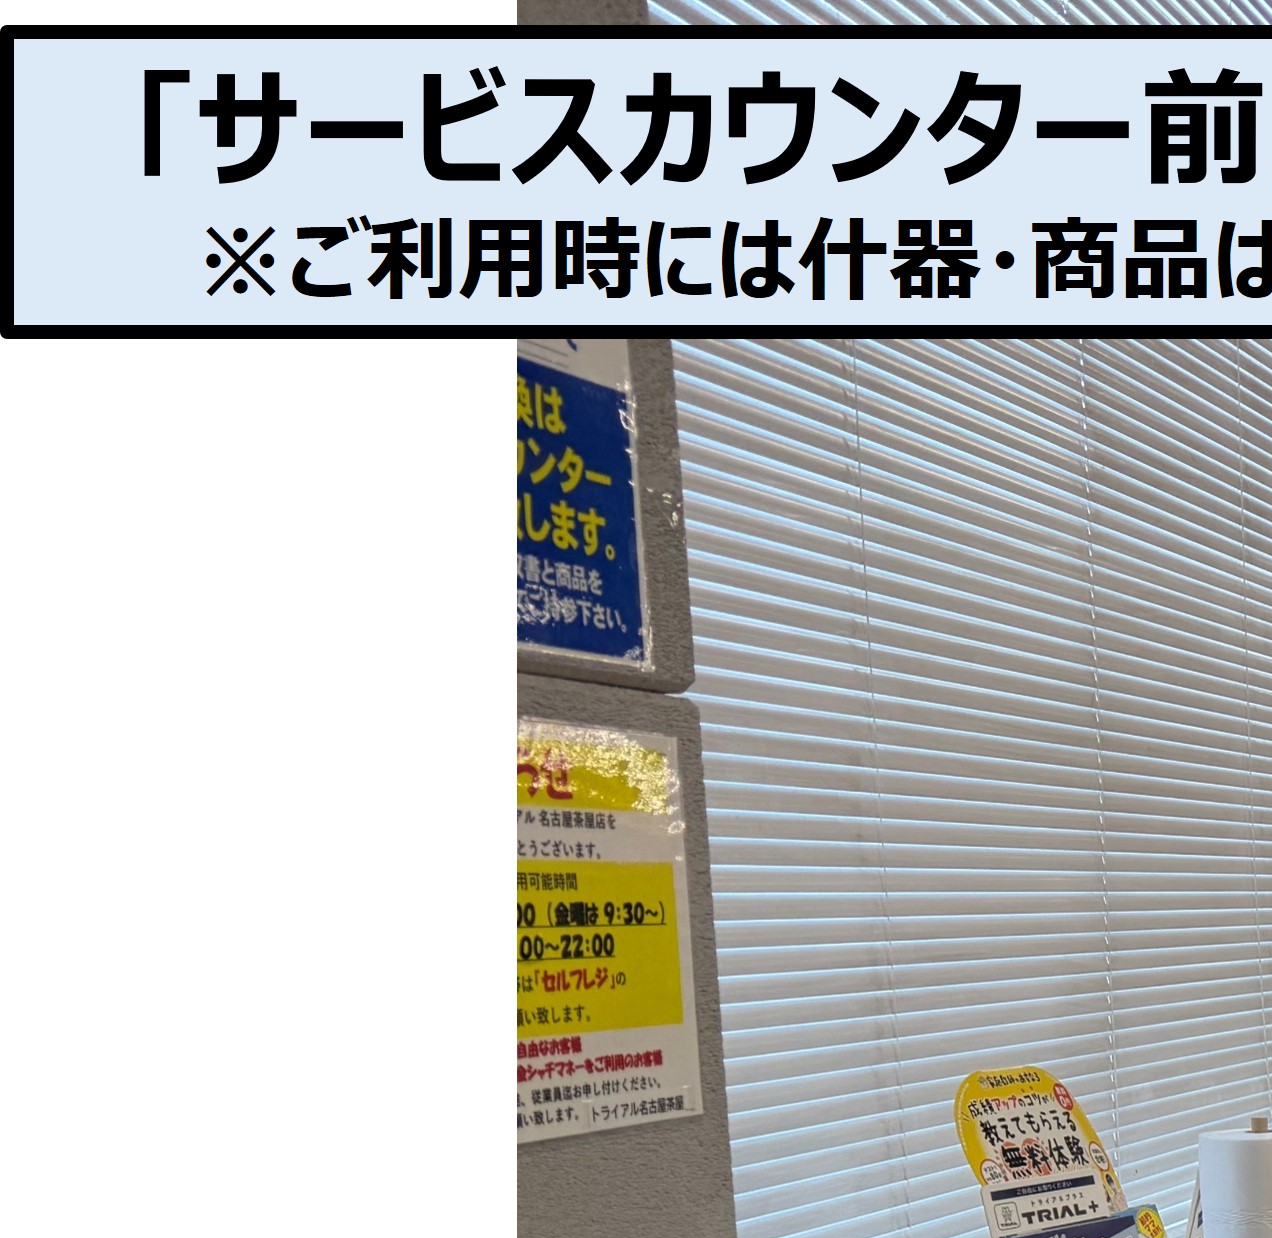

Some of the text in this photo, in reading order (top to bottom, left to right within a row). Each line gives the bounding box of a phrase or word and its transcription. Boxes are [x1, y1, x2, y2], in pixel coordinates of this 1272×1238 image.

[980, 1109, 1077, 1147] 教えてもらえる
[1002, 1135, 1090, 1180] 無料体験
